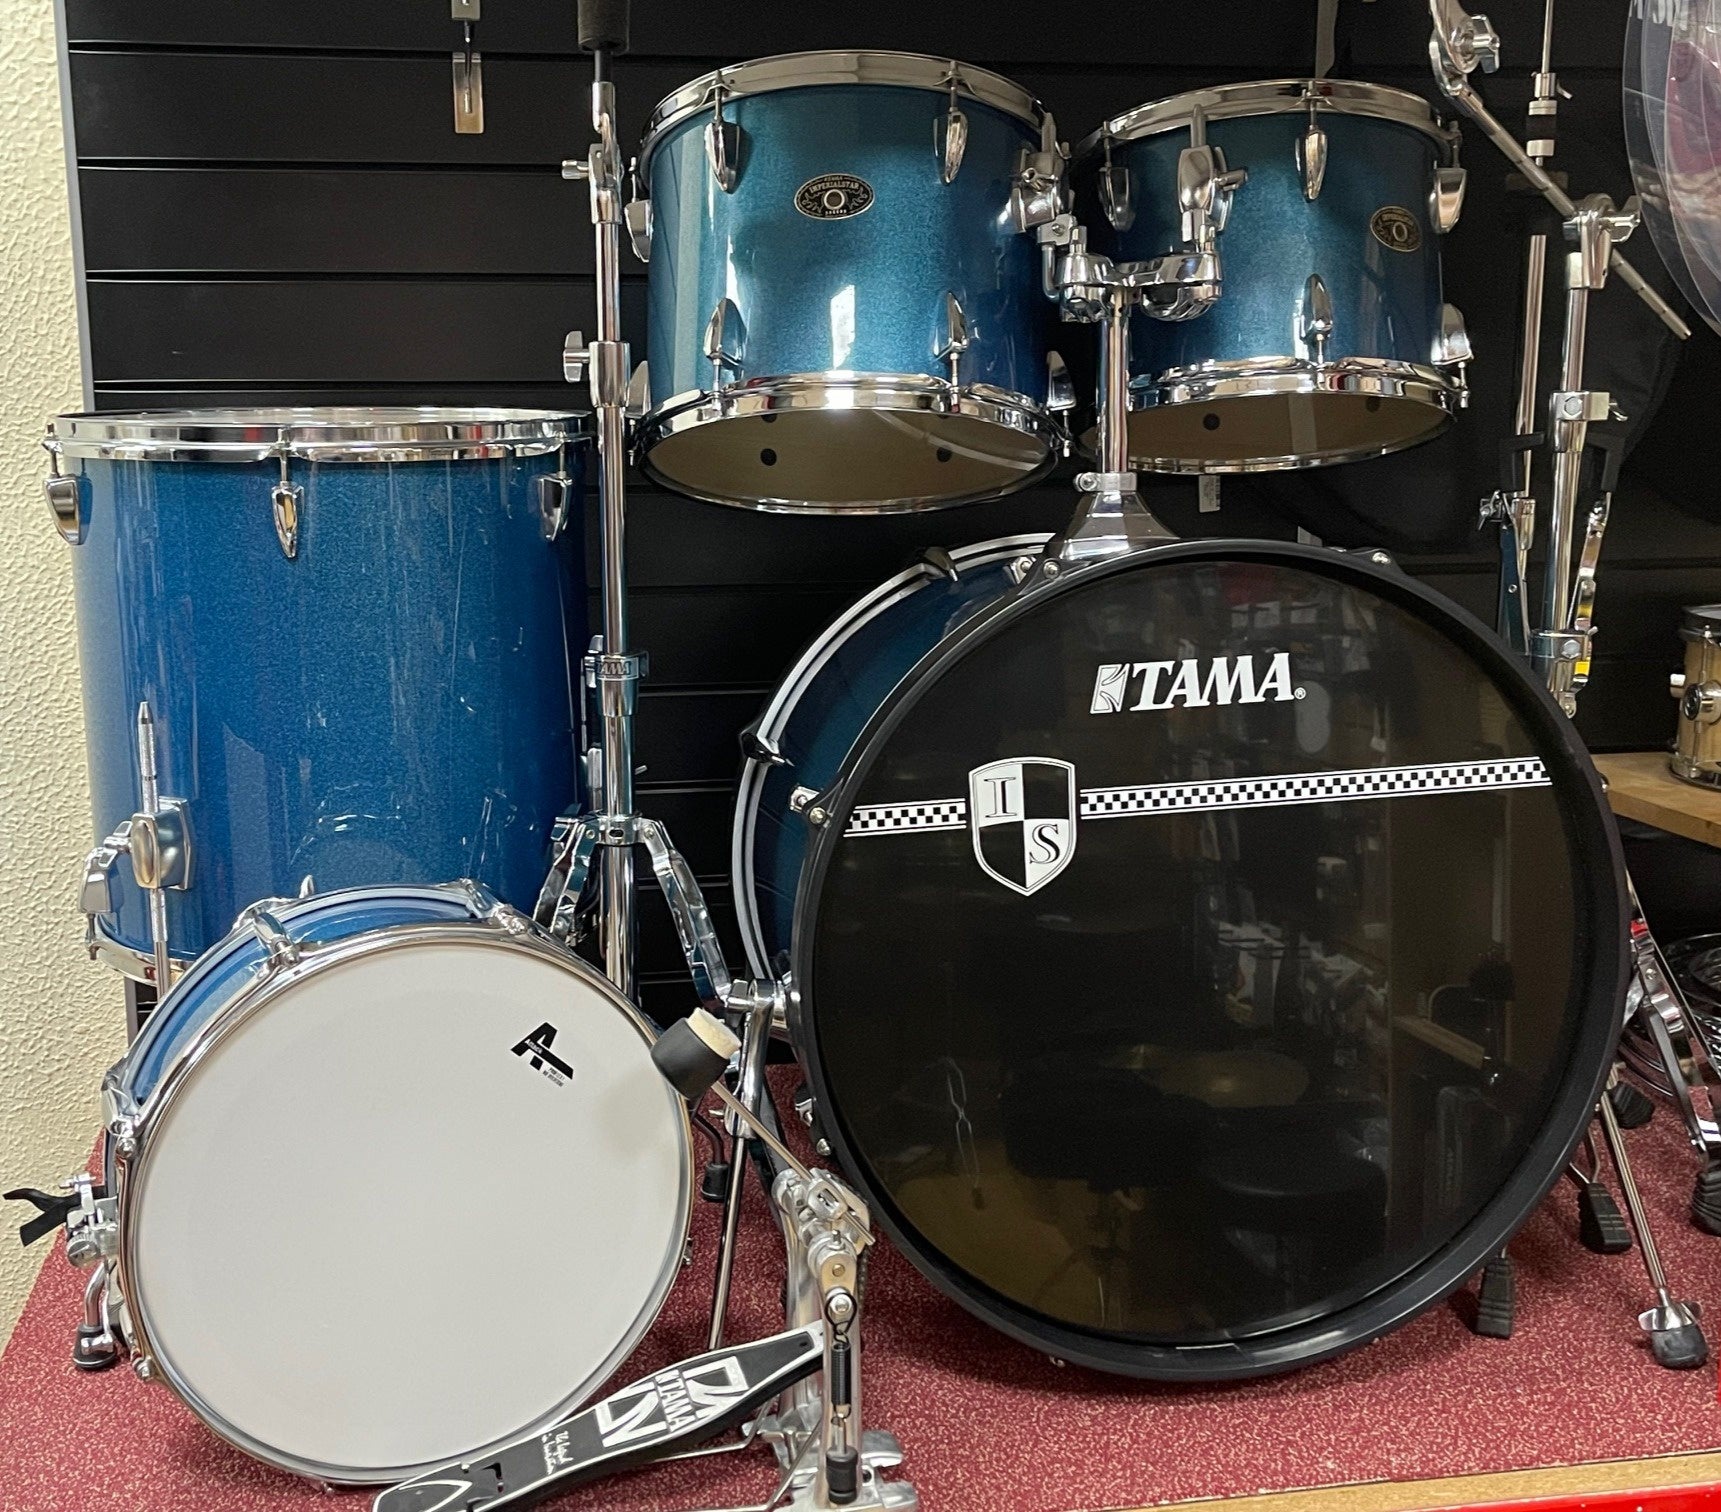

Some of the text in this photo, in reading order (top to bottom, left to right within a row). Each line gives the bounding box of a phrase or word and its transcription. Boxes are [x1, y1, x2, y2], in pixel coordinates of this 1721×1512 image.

[808, 181, 860, 194] IMPERIALSTAR
[1129, 652, 1295, 711] TAMA
[984, 776, 1017, 818] I
[1029, 823, 1061, 865] S
[657, 1377, 697, 1432] TAMA
